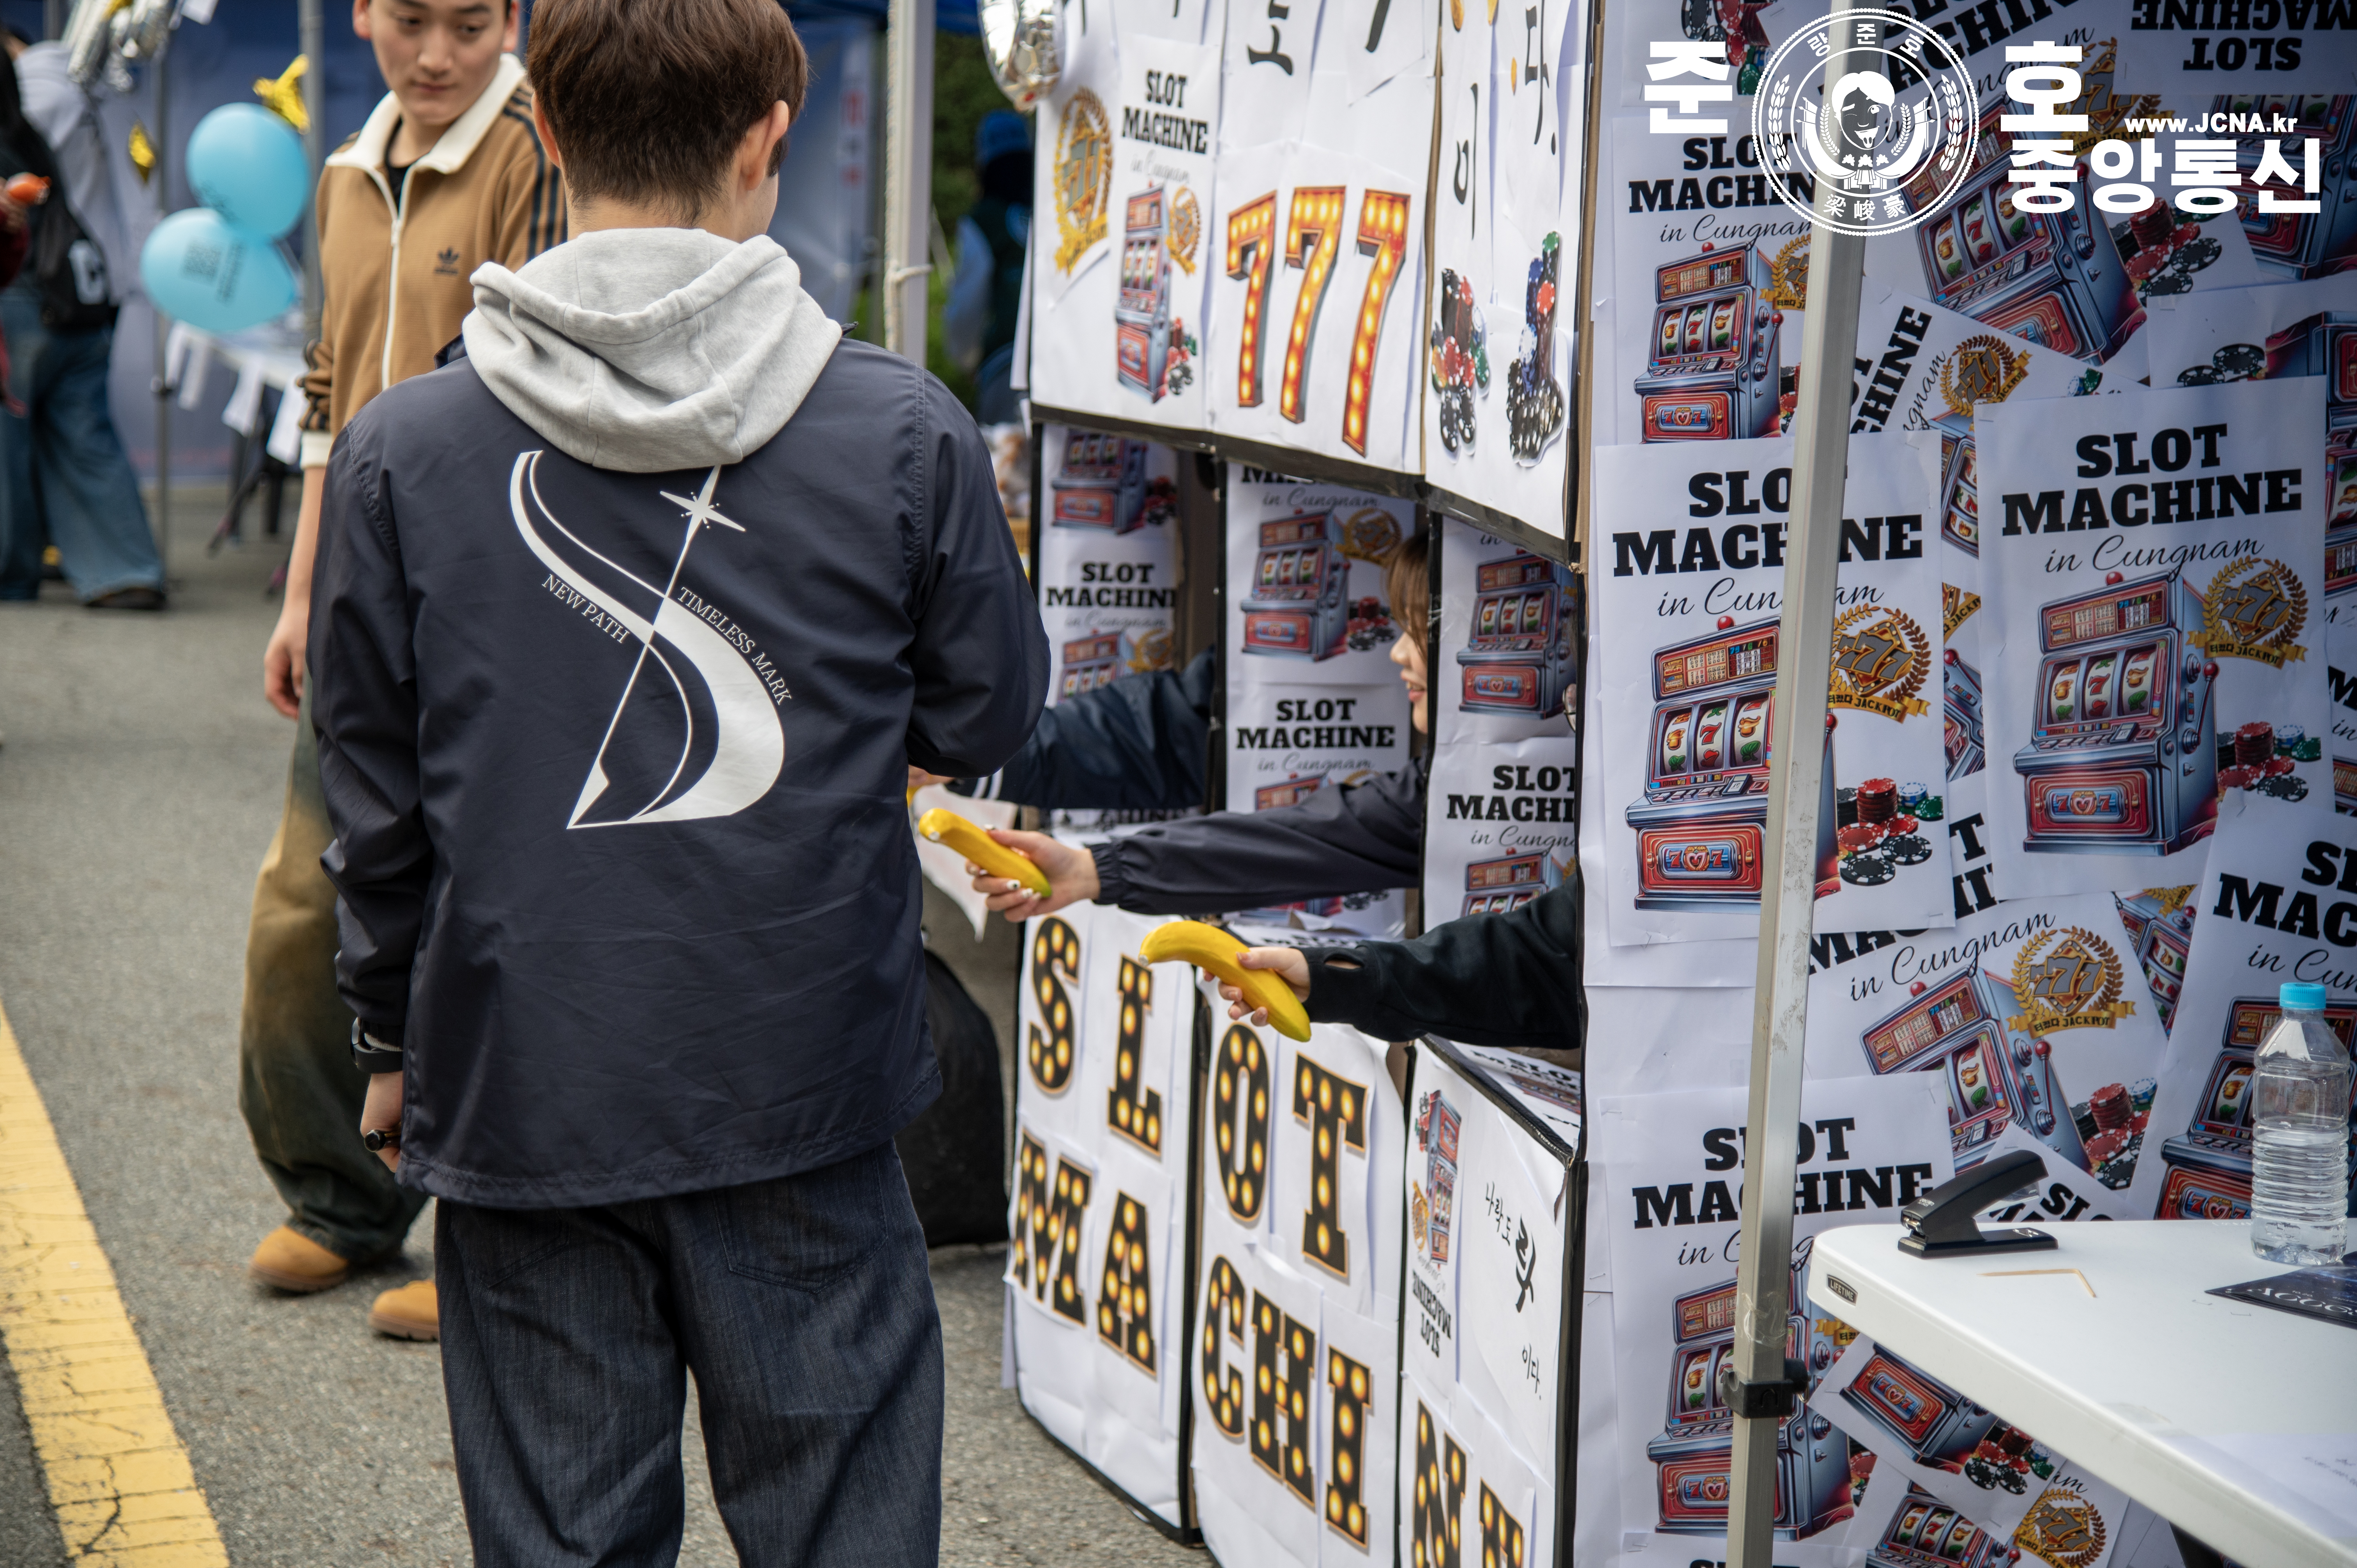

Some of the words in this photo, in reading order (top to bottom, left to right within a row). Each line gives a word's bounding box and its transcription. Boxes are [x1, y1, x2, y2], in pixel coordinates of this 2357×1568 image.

[2182, 38, 2302, 71] SLOT
[1145, 69, 1187, 108] SLOT
[1121, 106, 1208, 154] MACHINE
[1660, 222, 1686, 242] in
[1227, 185, 1411, 458] 777
[2076, 423, 2227, 479] SLOT
[1688, 468, 1847, 518] SLO
[2002, 469, 2302, 536] MACHINE
[1613, 514, 1922, 577] MACHNE
[2044, 549, 2083, 573] in
[2093, 535, 2264, 582] Cungnam
[1082, 562, 1155, 583] SLOT
[542, 574, 583, 611] NEW
[581, 602, 629, 643] PATH
[1657, 591, 1695, 617] in
[677, 586, 755, 654] TIMELESS
[751, 652, 792, 705] MARK
[2236, 646, 2280, 664] JACKPOT
[1276, 698, 1357, 722] SLOT
[1854, 697, 1901, 718] JACKPOT
[1236, 725, 1396, 750] MACHINE
[1471, 830, 1494, 845] in
[1851, 977, 1883, 1001] in
[1892, 913, 2056, 985] Cungnam
[2248, 944, 2286, 972] in
[2062, 1016, 2110, 1027] JACKPOT
[1632, 1163, 1933, 1229] MAHINE
[1678, 1242, 1714, 1266] in
[1413, 1269, 1451, 1340] MACHINE
[1830, 1279, 1854, 1301] LIFETIME
